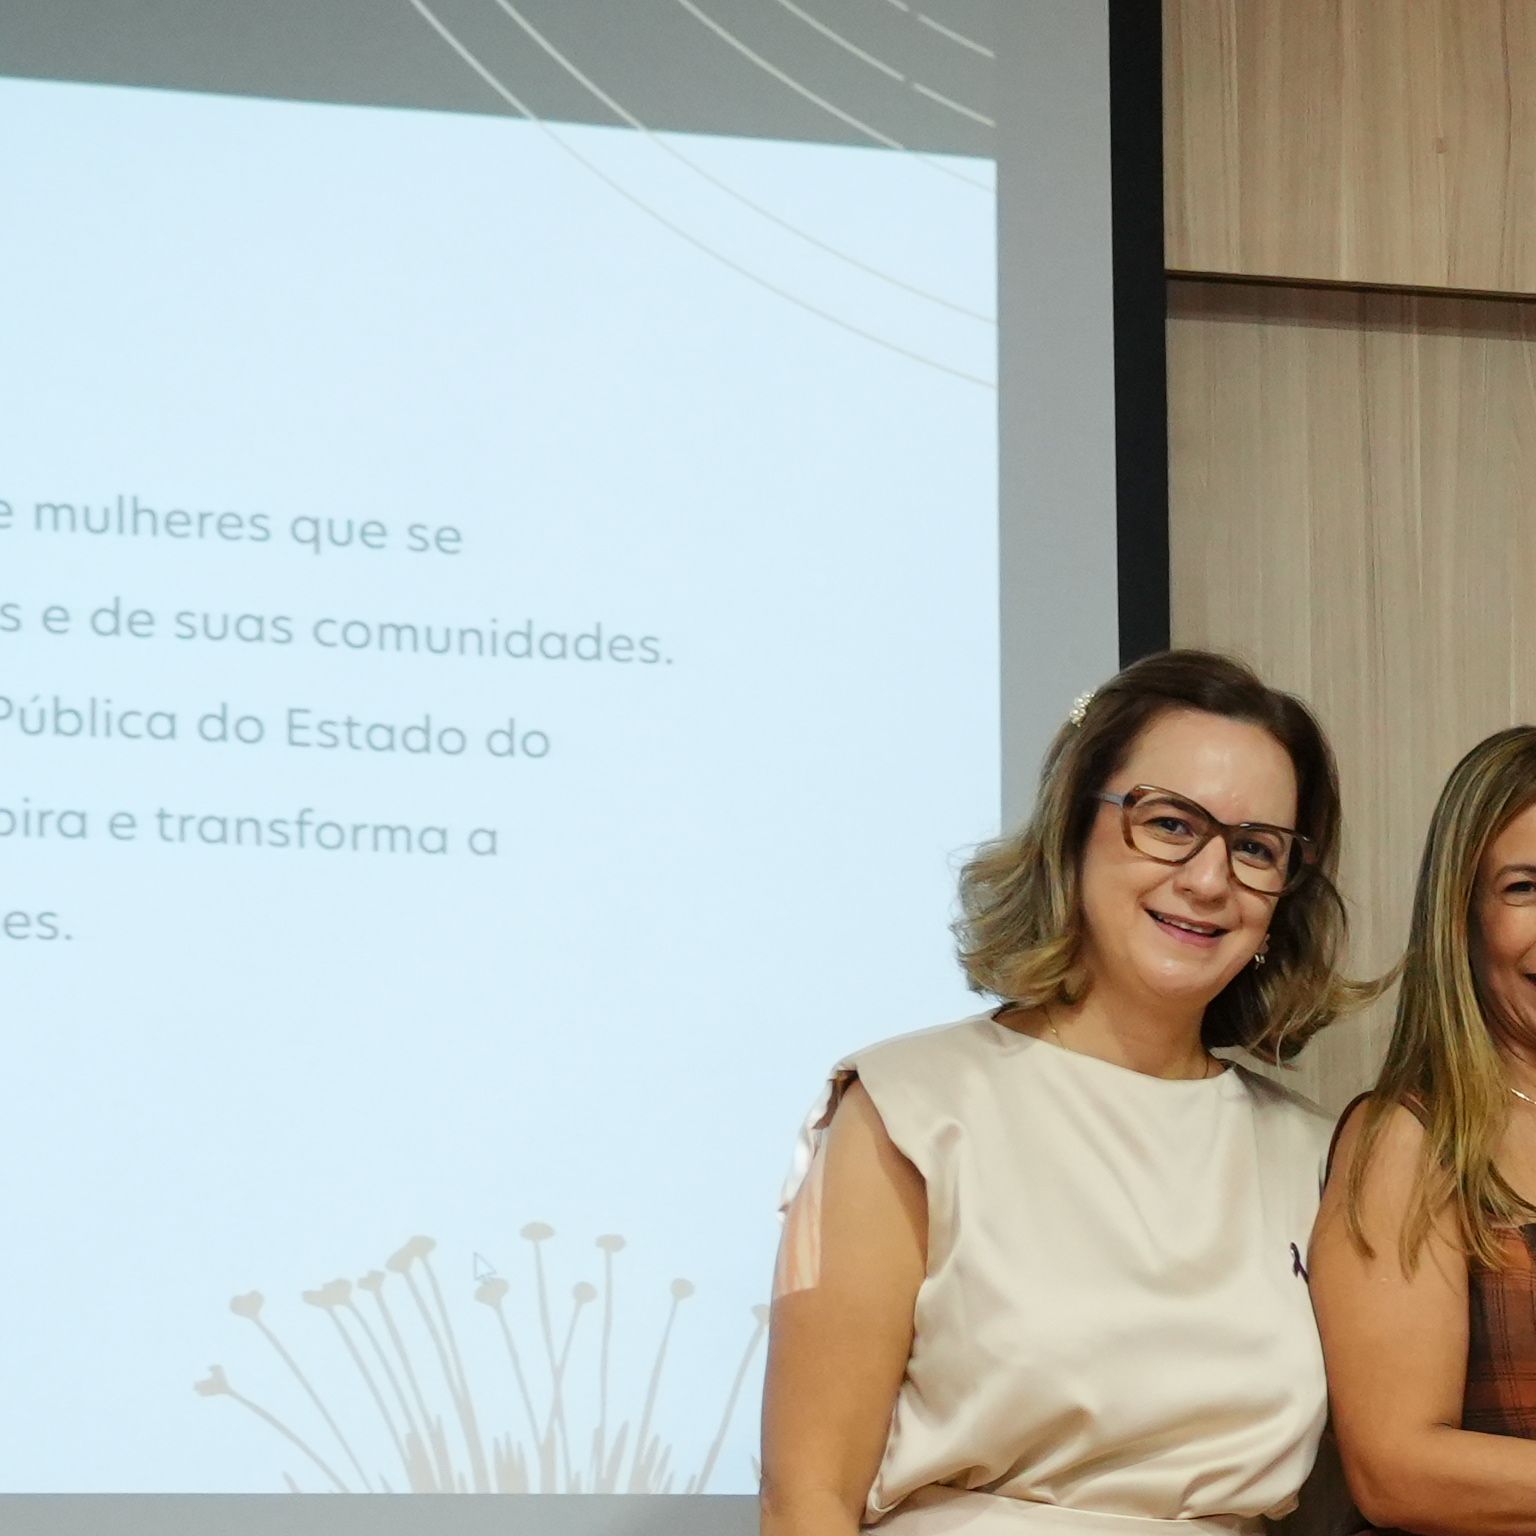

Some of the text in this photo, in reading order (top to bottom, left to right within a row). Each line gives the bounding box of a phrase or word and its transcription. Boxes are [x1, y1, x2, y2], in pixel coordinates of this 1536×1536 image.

[34, 494, 272, 543] mulheres
[290, 513, 389, 556] que
[406, 522, 463, 556] se
[42, 604, 71, 635] e
[90, 595, 156, 639] de
[174, 610, 294, 645] suas
[312, 617, 674, 666] comunidades.
[197, 701, 266, 745] do
[286, 707, 468, 756] Estado
[486, 717, 551, 759] do
[108, 811, 138, 842] e
[155, 807, 449, 855] transforma
[468, 827, 498, 857] a
